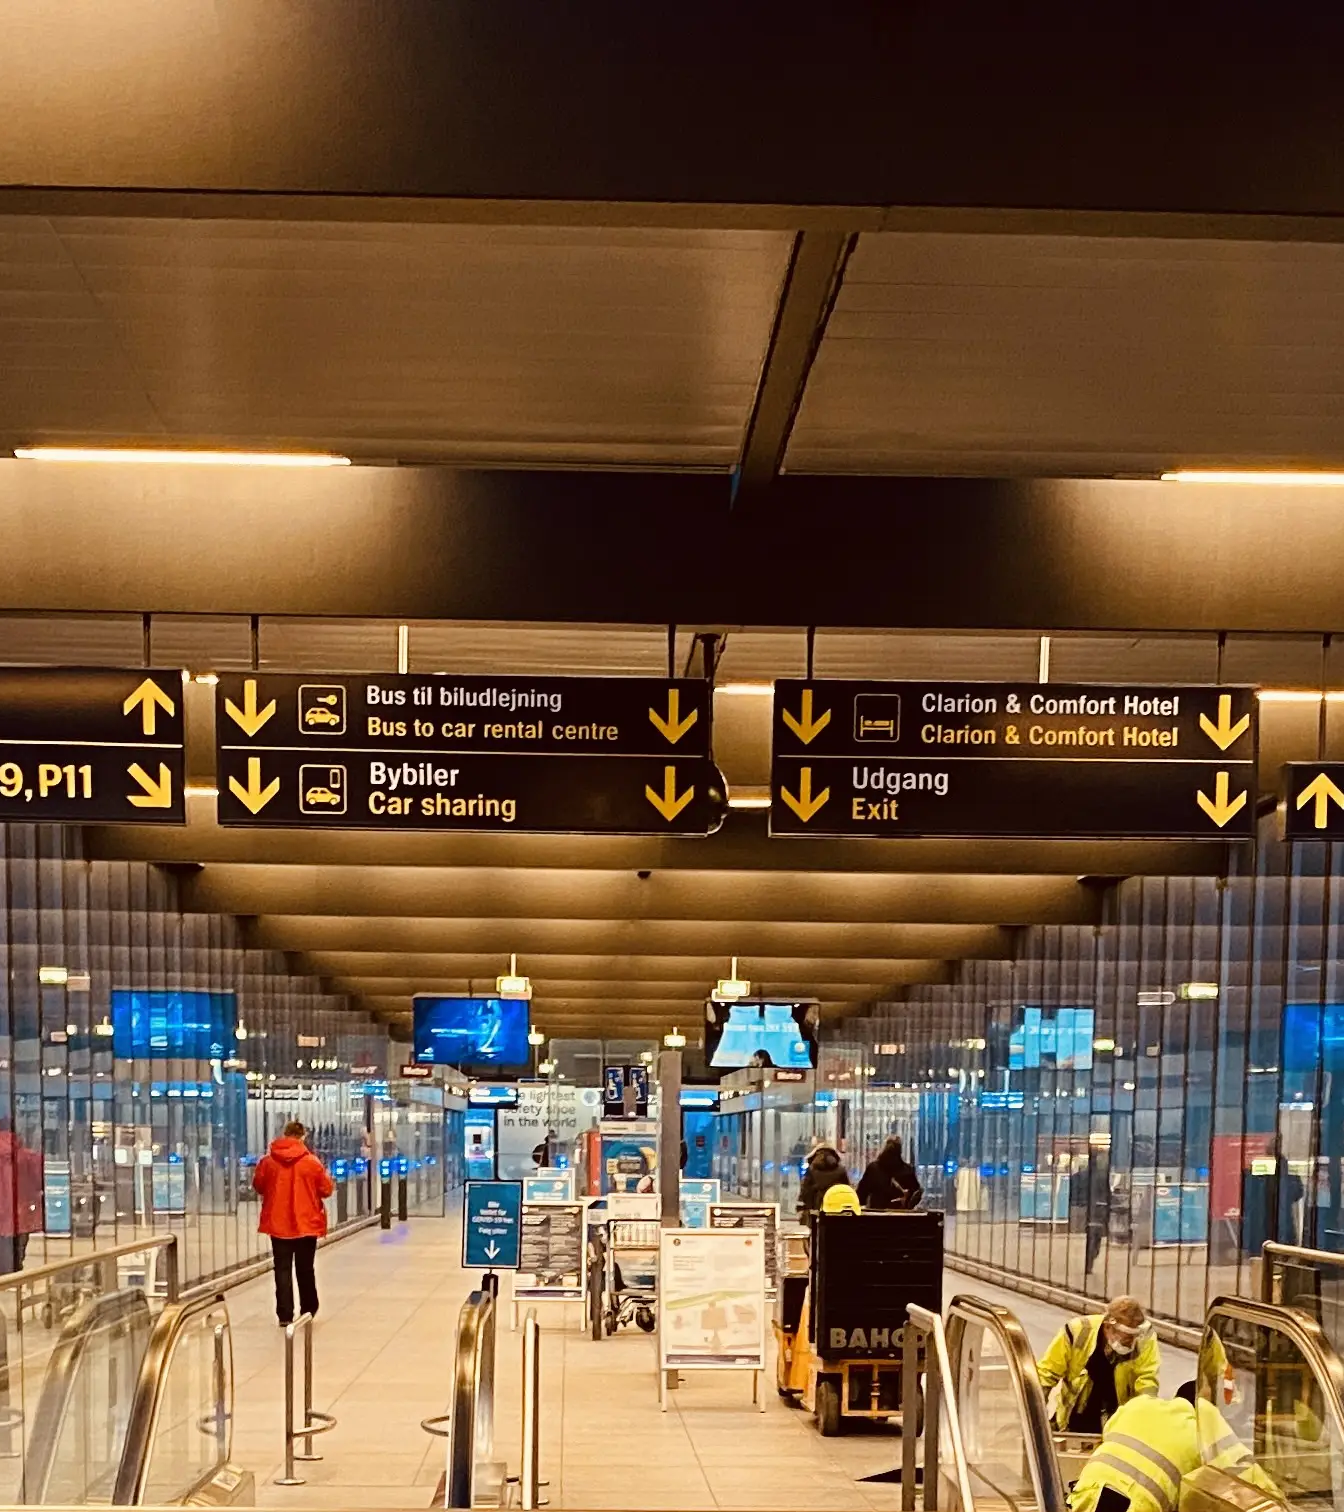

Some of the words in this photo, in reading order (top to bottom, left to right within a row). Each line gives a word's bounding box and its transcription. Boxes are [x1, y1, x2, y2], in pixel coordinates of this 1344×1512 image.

[366, 685, 406, 706] Bus
[412, 686, 433, 706] til
[439, 686, 562, 712] biludlejning
[921, 693, 997, 714] Clarion
[1005, 693, 1022, 714] &
[1029, 694, 1117, 716] Comfort
[1123, 695, 1180, 717] Hotel
[367, 716, 407, 737] Bus
[413, 718, 435, 738] to
[441, 722, 476, 738] car
[483, 720, 543, 740] rental
[551, 722, 619, 741] centre
[921, 724, 997, 746] Clarion
[1004, 724, 1021, 746] &
[1029, 725, 1116, 747] Comfort
[1122, 726, 1179, 748] Hotel
[39, 763, 92, 799] P11
[370, 761, 460, 789] Bybiler
[852, 766, 949, 795] Udgang
[368, 791, 414, 815] Car
[420, 793, 516, 823] sharing
[852, 797, 899, 821] Exit
[504, 1116, 515, 1127] in
[519, 1117, 538, 1127] the
[542, 1117, 576, 1128] world
